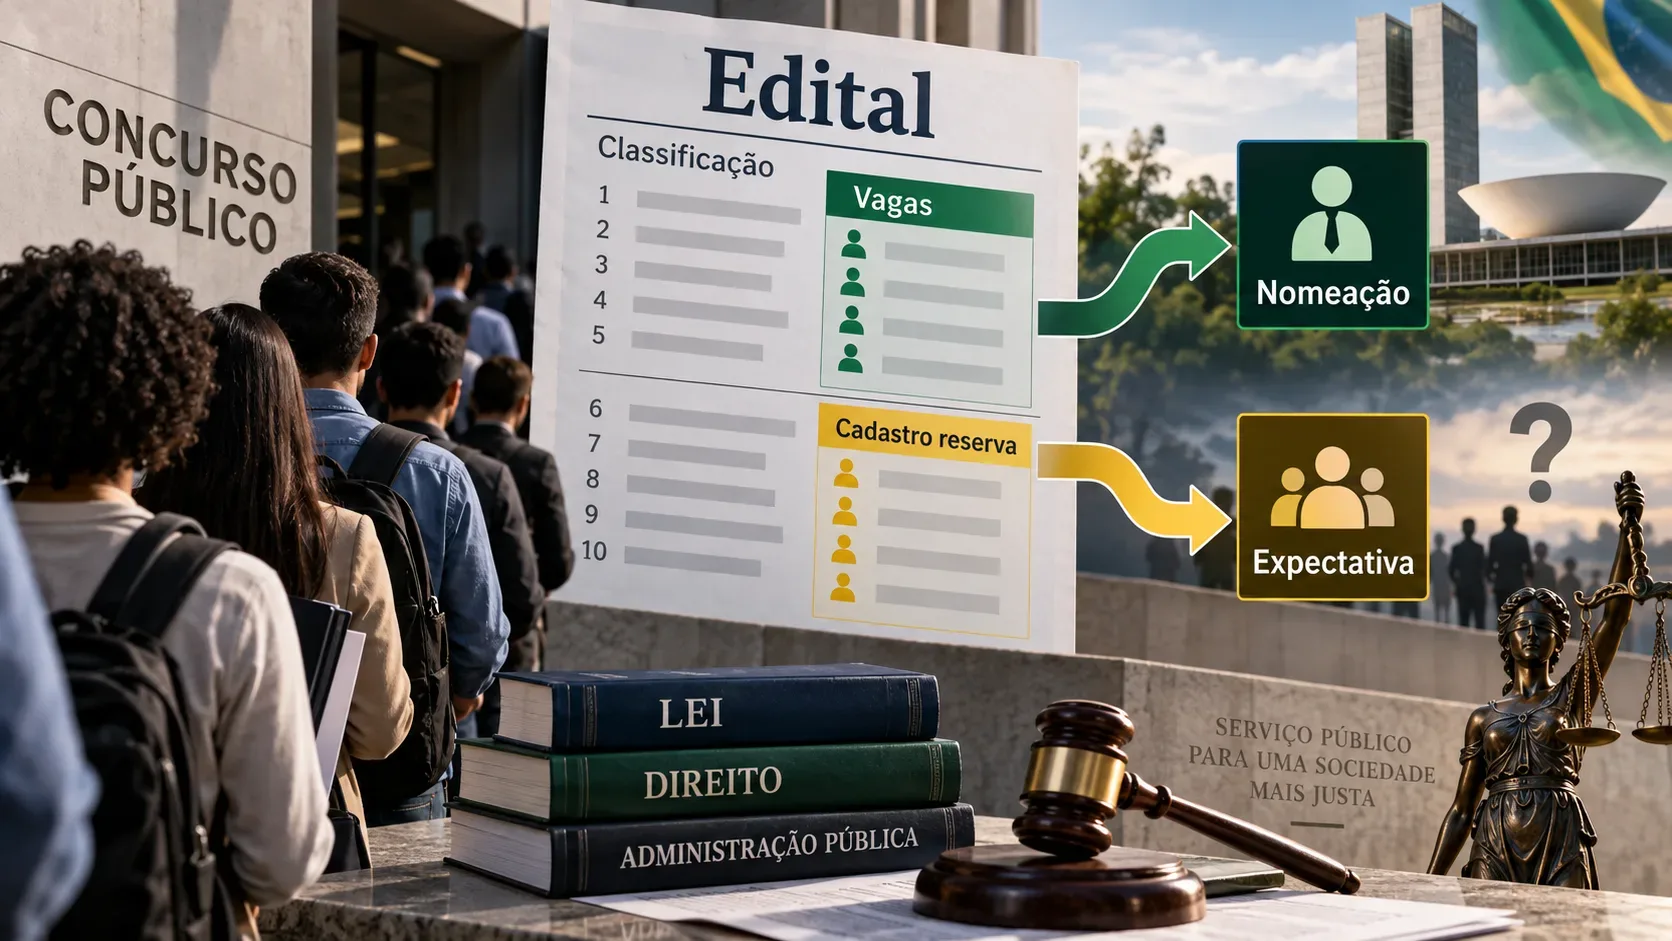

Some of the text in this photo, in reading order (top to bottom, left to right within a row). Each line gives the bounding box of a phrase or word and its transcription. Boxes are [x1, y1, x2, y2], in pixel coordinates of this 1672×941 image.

[702, 47, 936, 139] Edital
[44, 89, 297, 205] CONCURSO
[598, 134, 775, 180] Classificação
[82, 159, 277, 255] PÚBLICO
[598, 186, 610, 204] 1
[853, 185, 933, 219] Vagas
[596, 220, 610, 239] 2
[595, 255, 609, 275] 3
[593, 290, 608, 310] 4
[592, 326, 606, 345] 5
[589, 398, 603, 418] 6
[588, 433, 601, 453] 7
[835, 417, 1018, 455] Cadastro reserva
[586, 469, 600, 489] 8
[585, 504, 599, 524] 9
[581, 540, 607, 562] 10
[659, 697, 723, 730] LEI
[1215, 717, 1412, 755] SERVIÇO PÚBLICO
[1188, 745, 1435, 784] PARA UMA SOCIEDADE
[644, 765, 782, 800] DIREITO
[1250, 780, 1376, 808] MAIS JUSTA
[620, 826, 919, 870] ADMINISTRAÇÃO PÚBLICA
